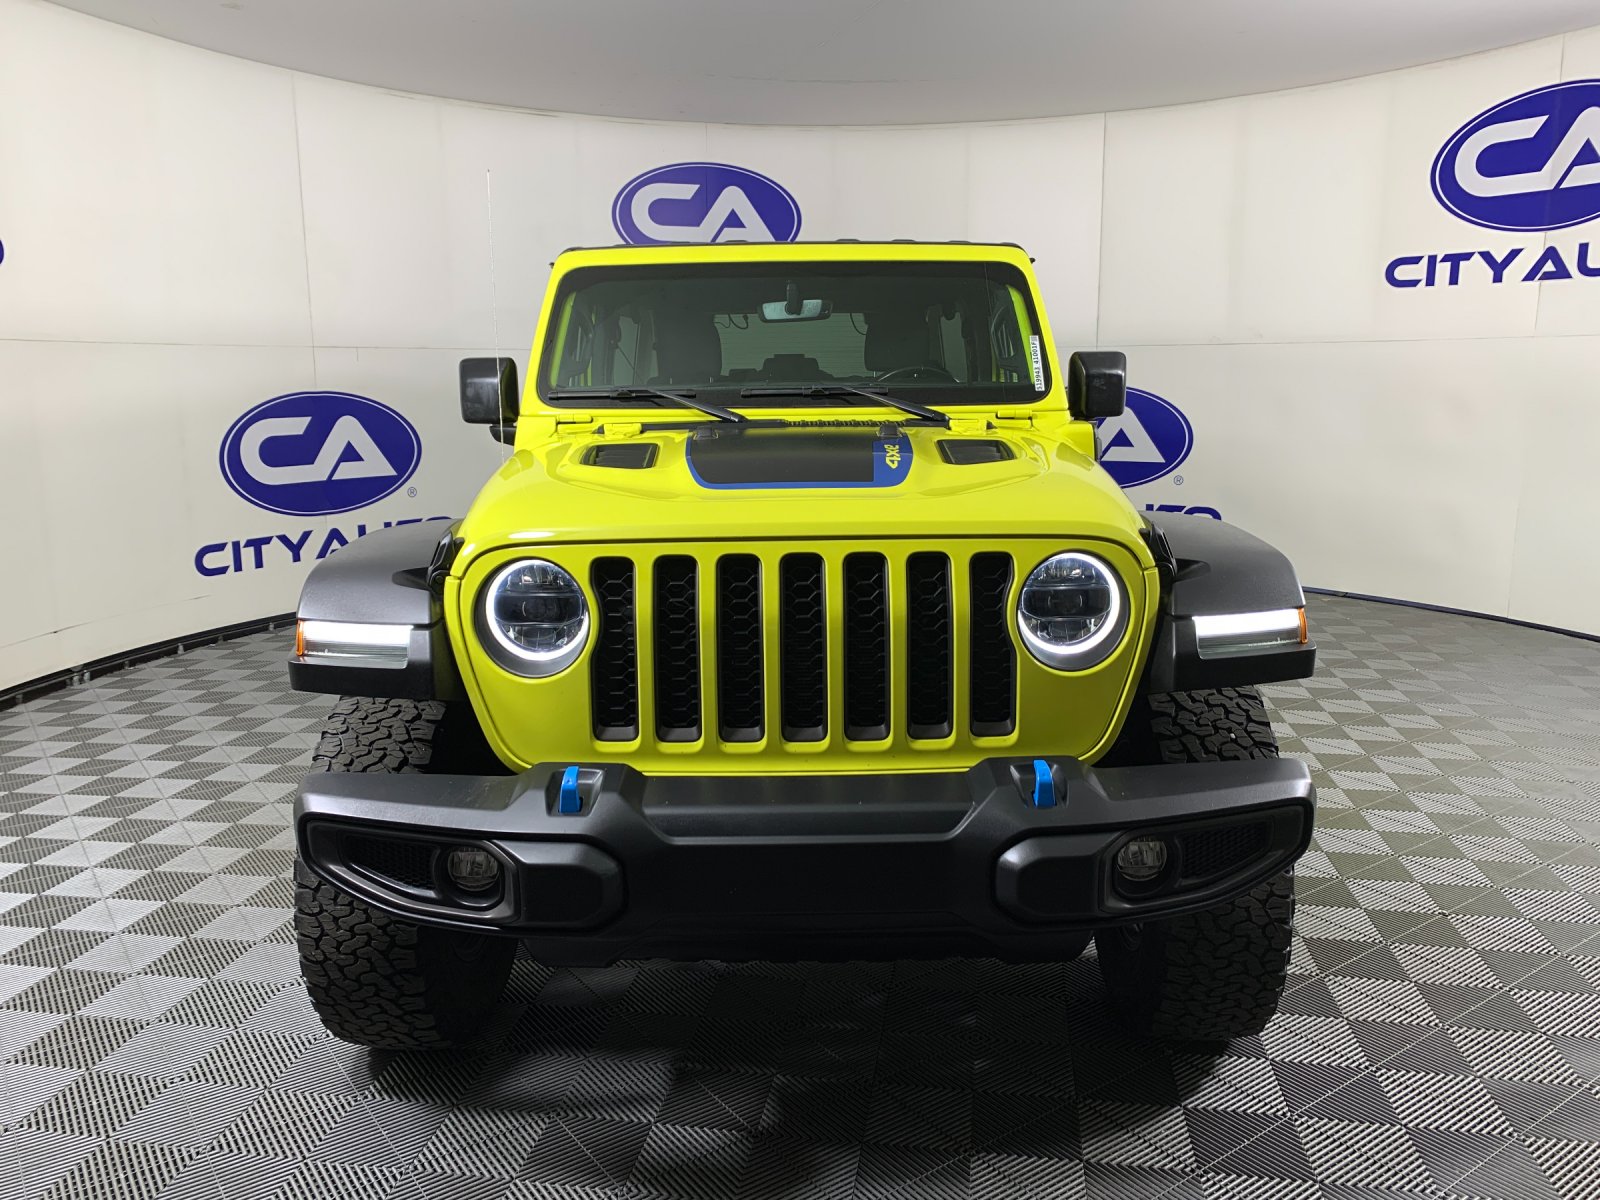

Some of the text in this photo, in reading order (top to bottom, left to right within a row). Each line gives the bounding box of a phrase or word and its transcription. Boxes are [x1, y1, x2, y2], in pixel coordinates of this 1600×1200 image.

[631, 182, 777, 243] CA
[1384, 247, 1525, 288] CITY
[239, 414, 398, 486] CA
[194, 529, 314, 577] CITY
